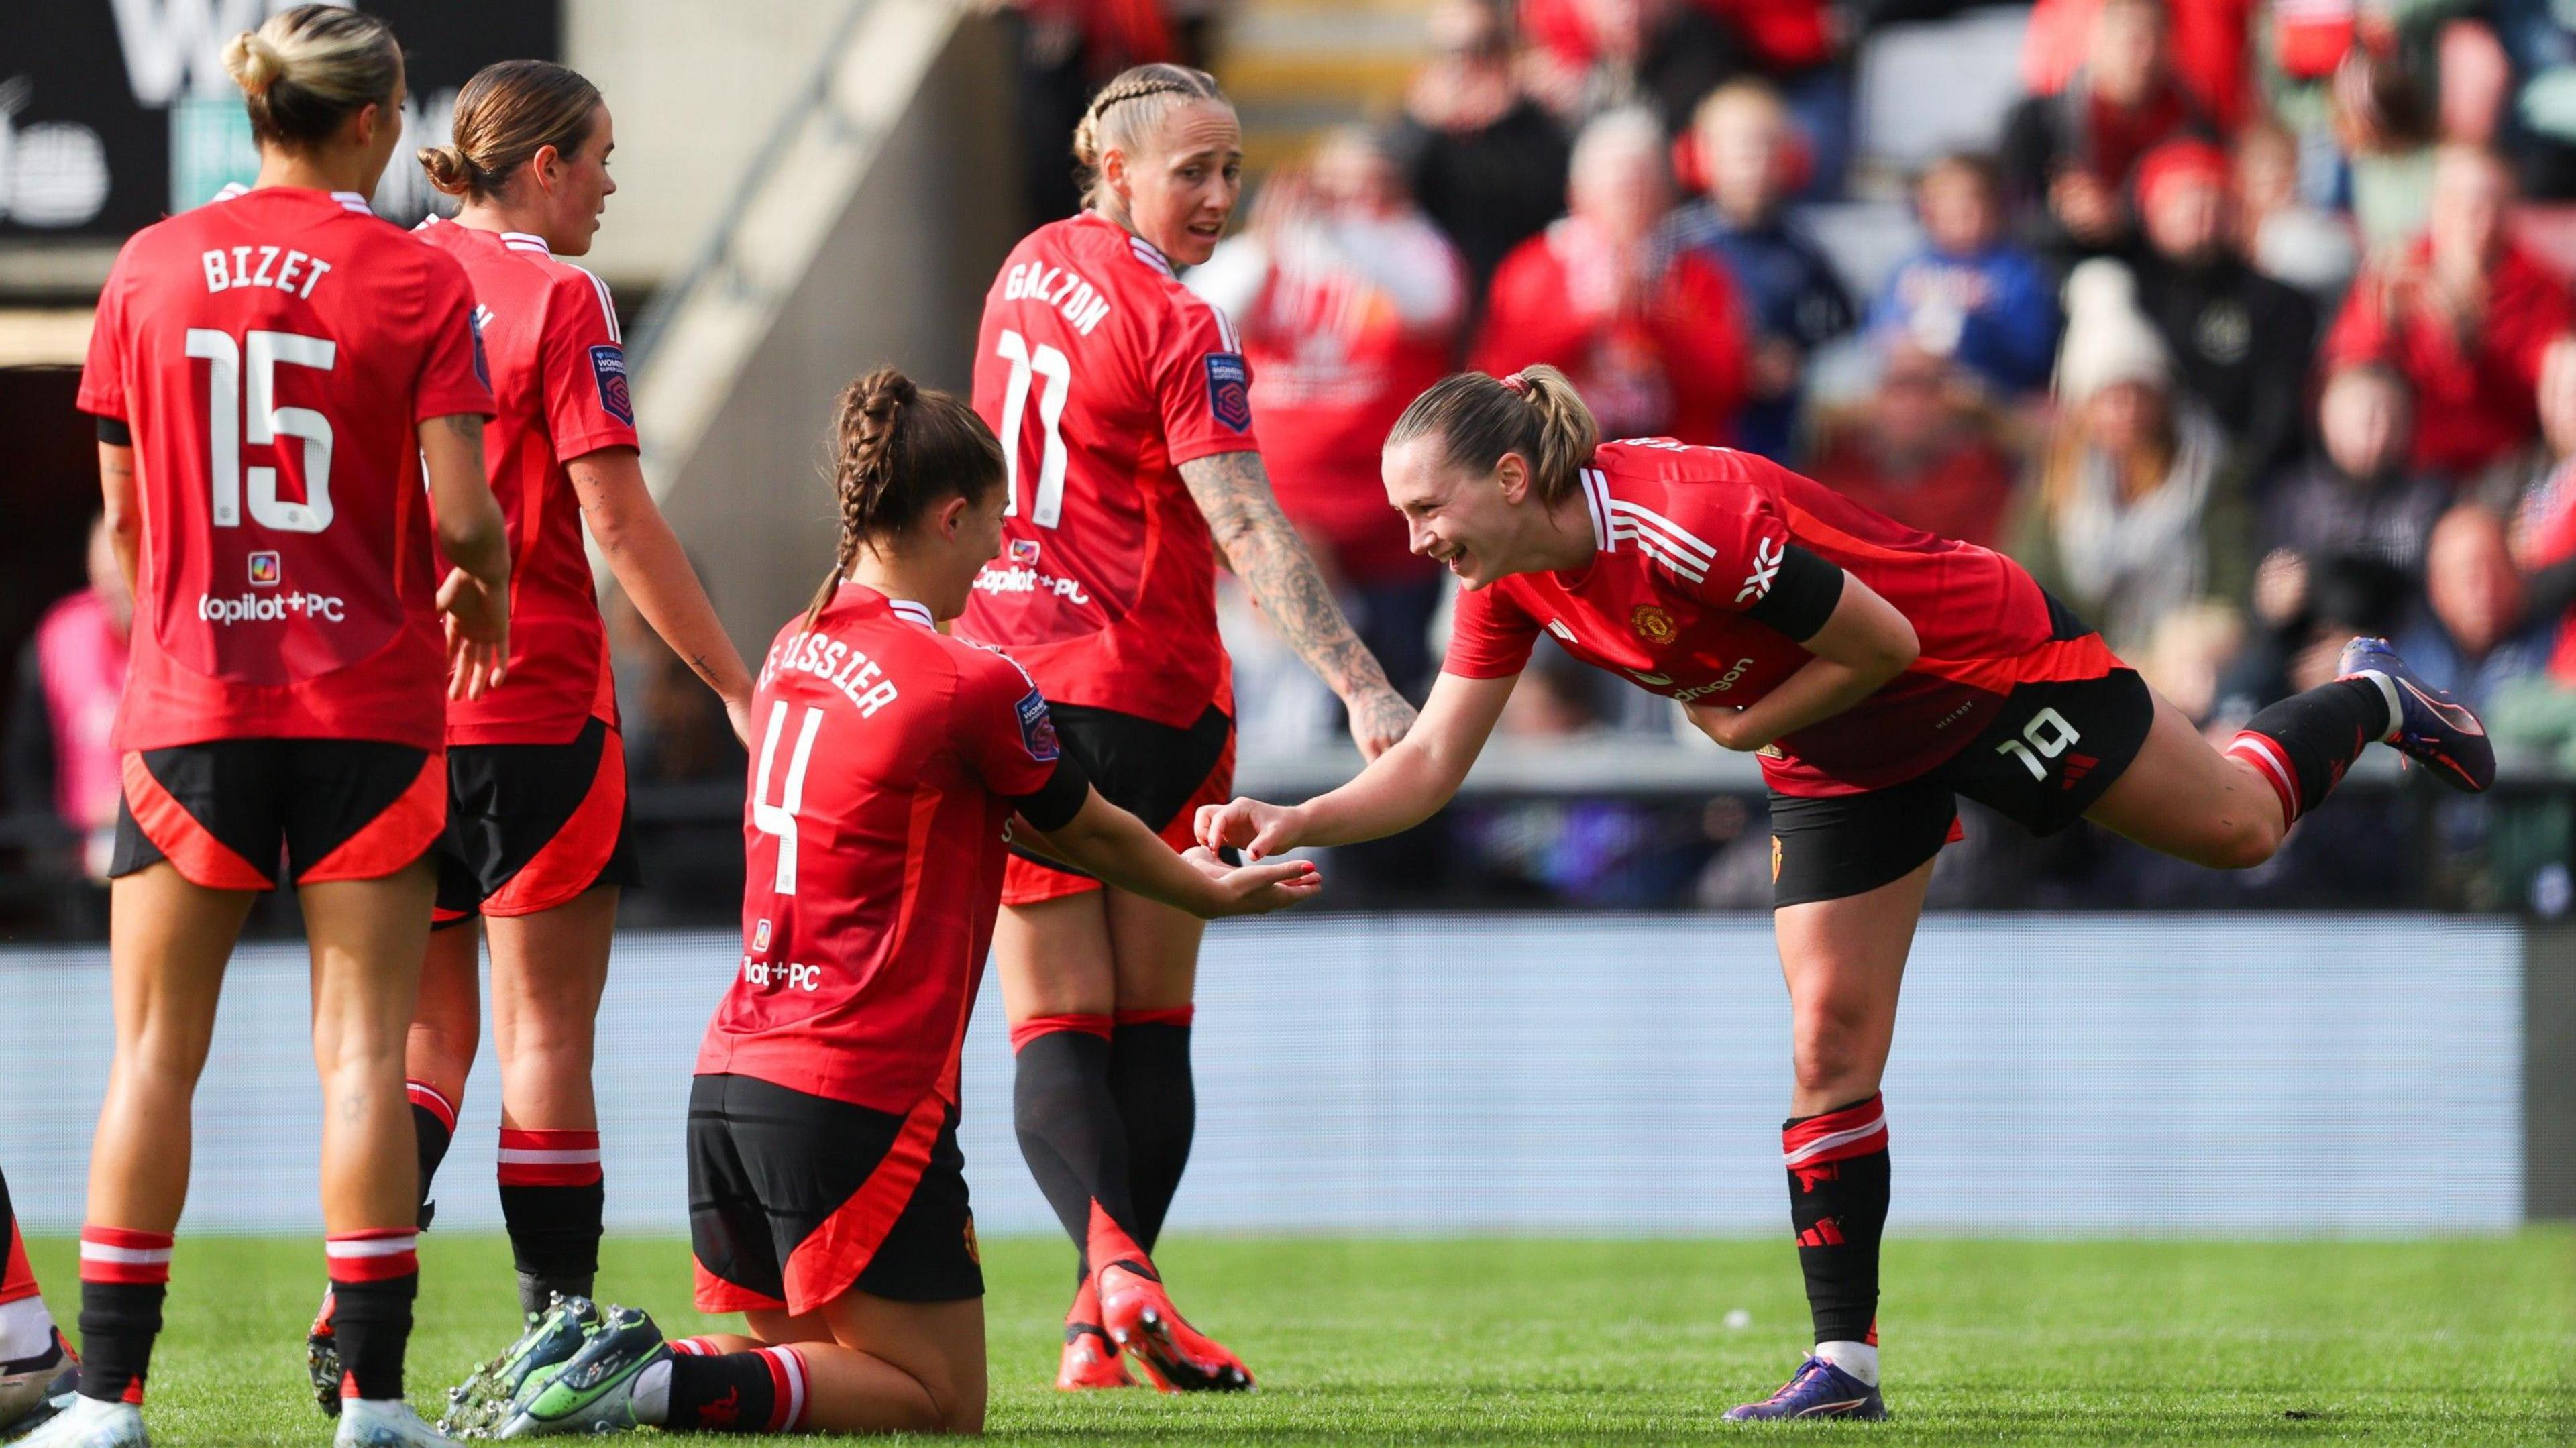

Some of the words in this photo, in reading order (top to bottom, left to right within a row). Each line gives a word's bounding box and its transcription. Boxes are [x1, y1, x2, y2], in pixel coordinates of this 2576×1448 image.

[203, 245, 332, 300] BIZET
[184, 327, 336, 534] 15
[996, 329, 1071, 530] 11
[753, 700, 824, 895] 4
[1996, 707, 2080, 782] 19
